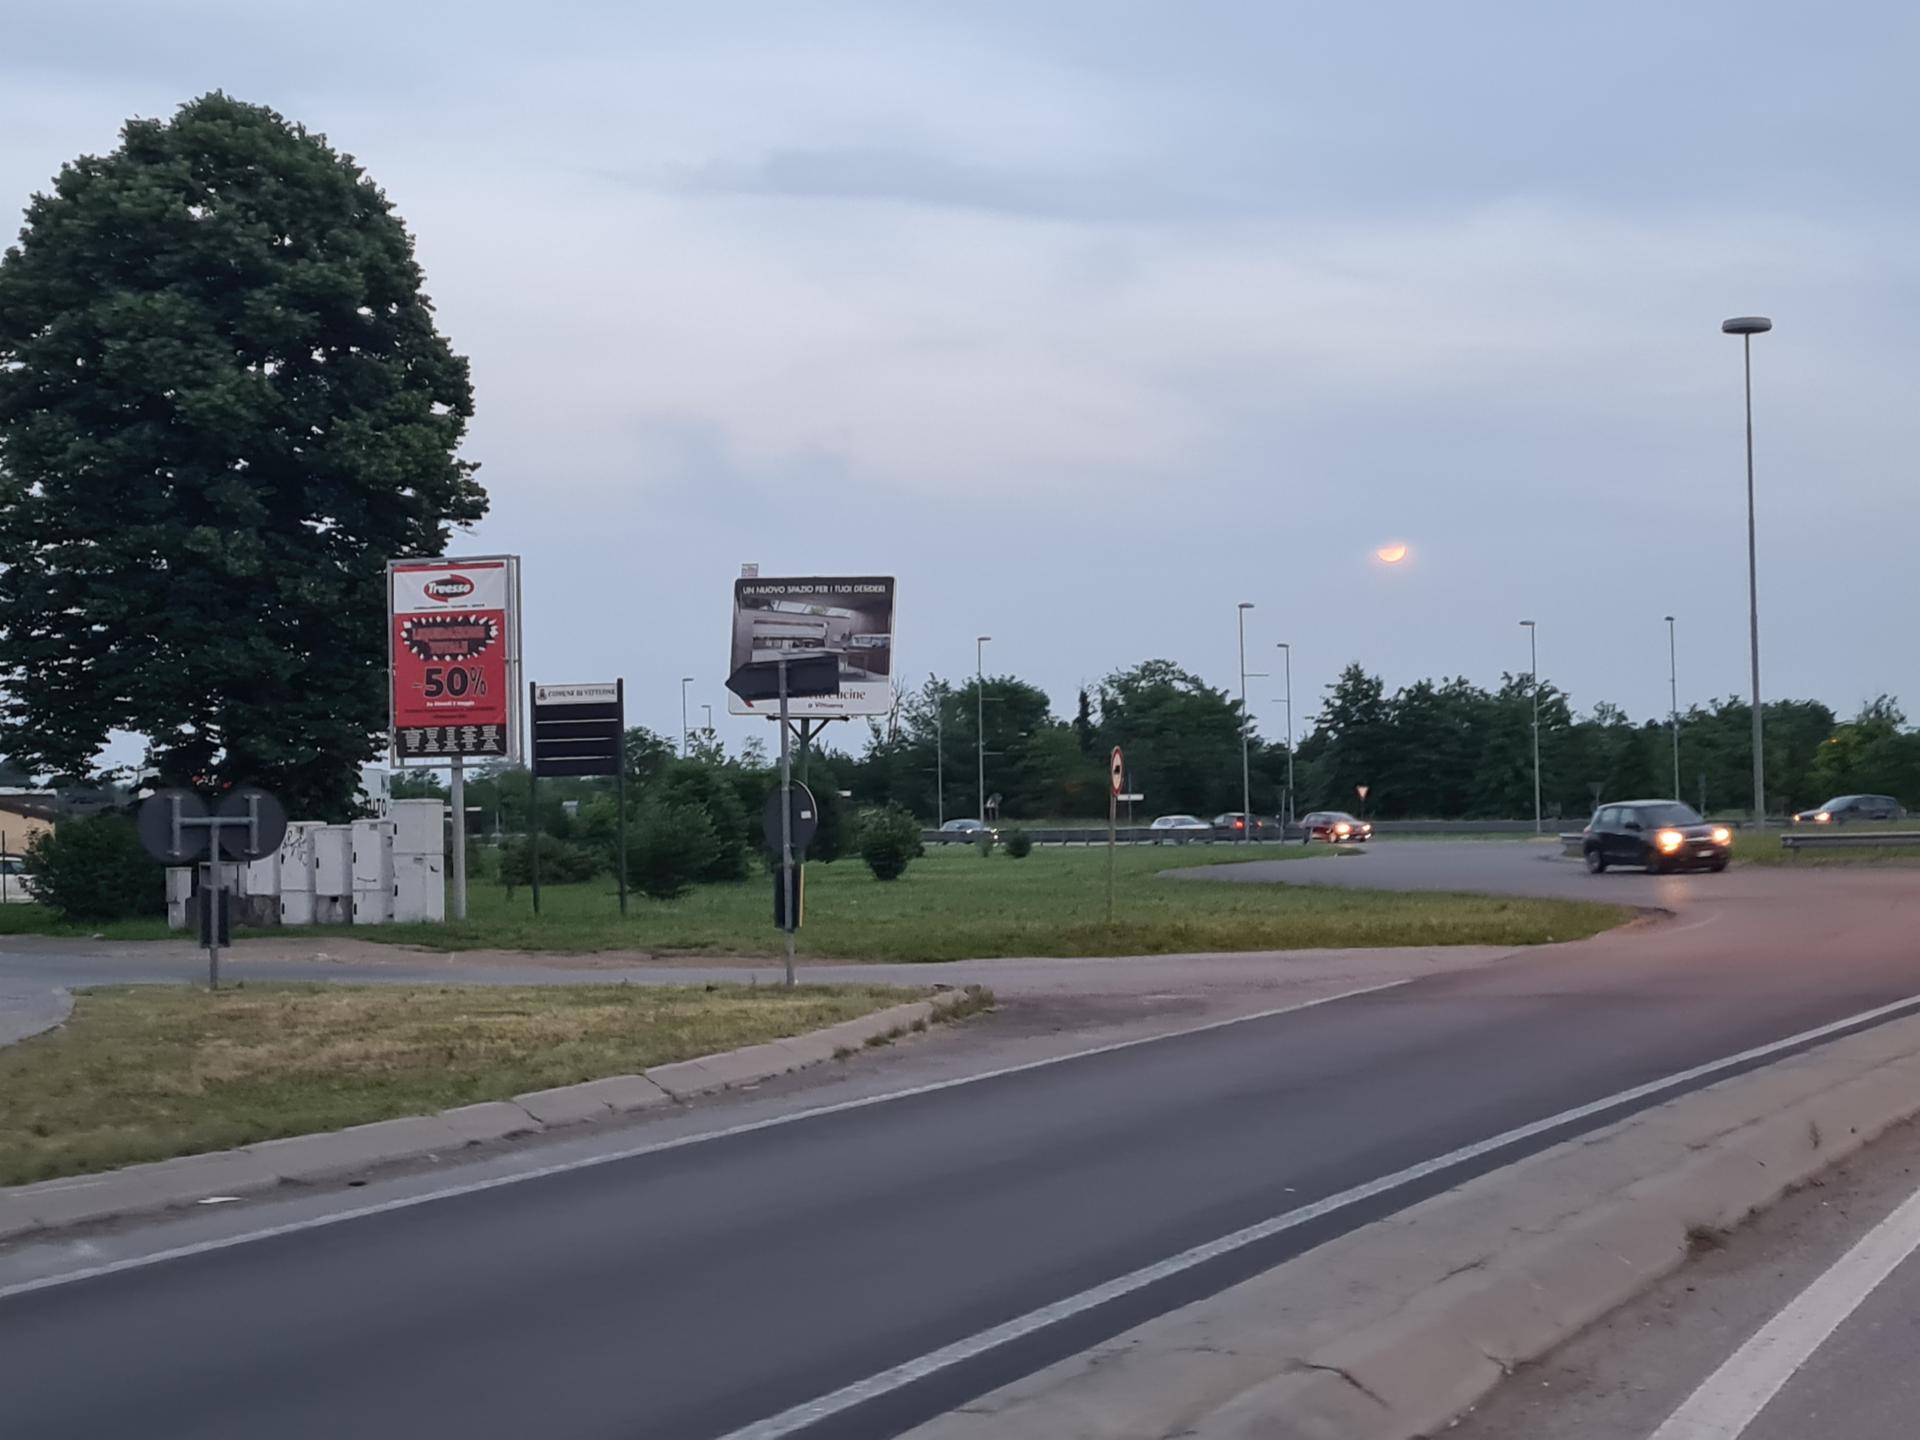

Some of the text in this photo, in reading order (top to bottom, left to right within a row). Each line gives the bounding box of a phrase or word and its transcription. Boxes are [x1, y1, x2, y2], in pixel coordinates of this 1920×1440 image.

[743, 586, 755, 594] UN
[756, 585, 786, 594] NUOVO
[787, 584, 814, 593] SPAZIO
[815, 584, 829, 593] PER
[835, 584, 852, 592] TUOI
[854, 584, 886, 592] DESIDERI
